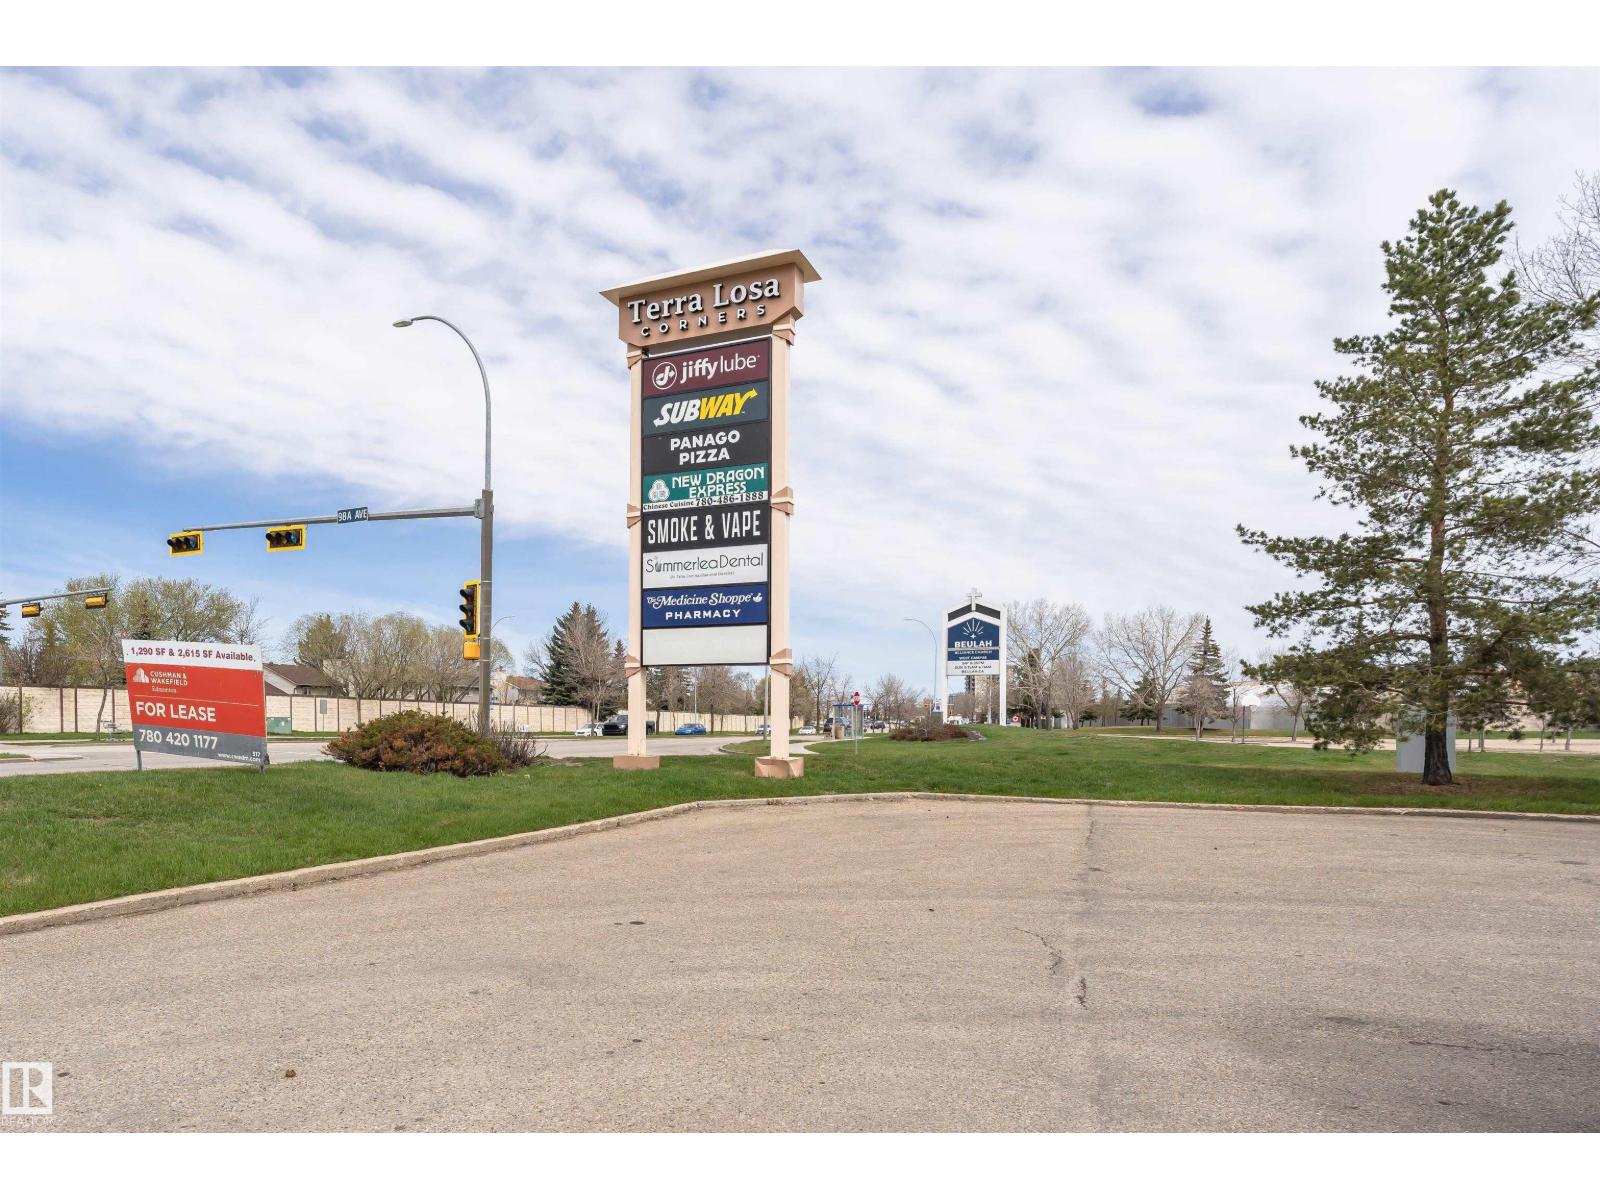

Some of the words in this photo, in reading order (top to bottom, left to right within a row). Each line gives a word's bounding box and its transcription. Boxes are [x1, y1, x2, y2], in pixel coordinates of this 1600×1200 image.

[627, 293, 703, 324] Terra
[712, 278, 780, 309] Losa
[640, 304, 767, 337] CORNERS
[680, 357, 719, 384] jiffy
[720, 354, 757, 373] lube
[653, 388, 758, 427] SUBWAY
[670, 430, 740, 451] PANAGO
[679, 447, 731, 466] PIZZA
[671, 474, 702, 489] NEW
[706, 466, 765, 485] DRAGON
[688, 481, 747, 499] EXPRESS
[643, 502, 669, 511] Chinese
[669, 500, 694, 508] Cuisine
[695, 492, 764, 506] 780-486-1888
[354, 509, 367, 519] AVE
[647, 515, 698, 544] SMOKE
[704, 514, 715, 540] &
[722, 509, 761, 538] VAPE
[653, 594, 708, 610] Medicine
[708, 592, 752, 606] Shoppe
[665, 609, 741, 620] PHARMACY
[131, 647, 153, 656] 1,290
[155, 648, 166, 656] SF
[168, 648, 175, 657] &
[177, 649, 201, 659] 2,615
[203, 650, 213, 659] SF
[954, 640, 993, 648] BEULAH
[150, 671, 182, 680] CUSHMAN
[150, 678, 188, 687] WAKEFIELD
[135, 701, 166, 718] FOR
[169, 703, 217, 722] LEASE
[139, 729, 162, 743] 780
[165, 731, 190, 747] 420
[192, 734, 218, 750] 1177
